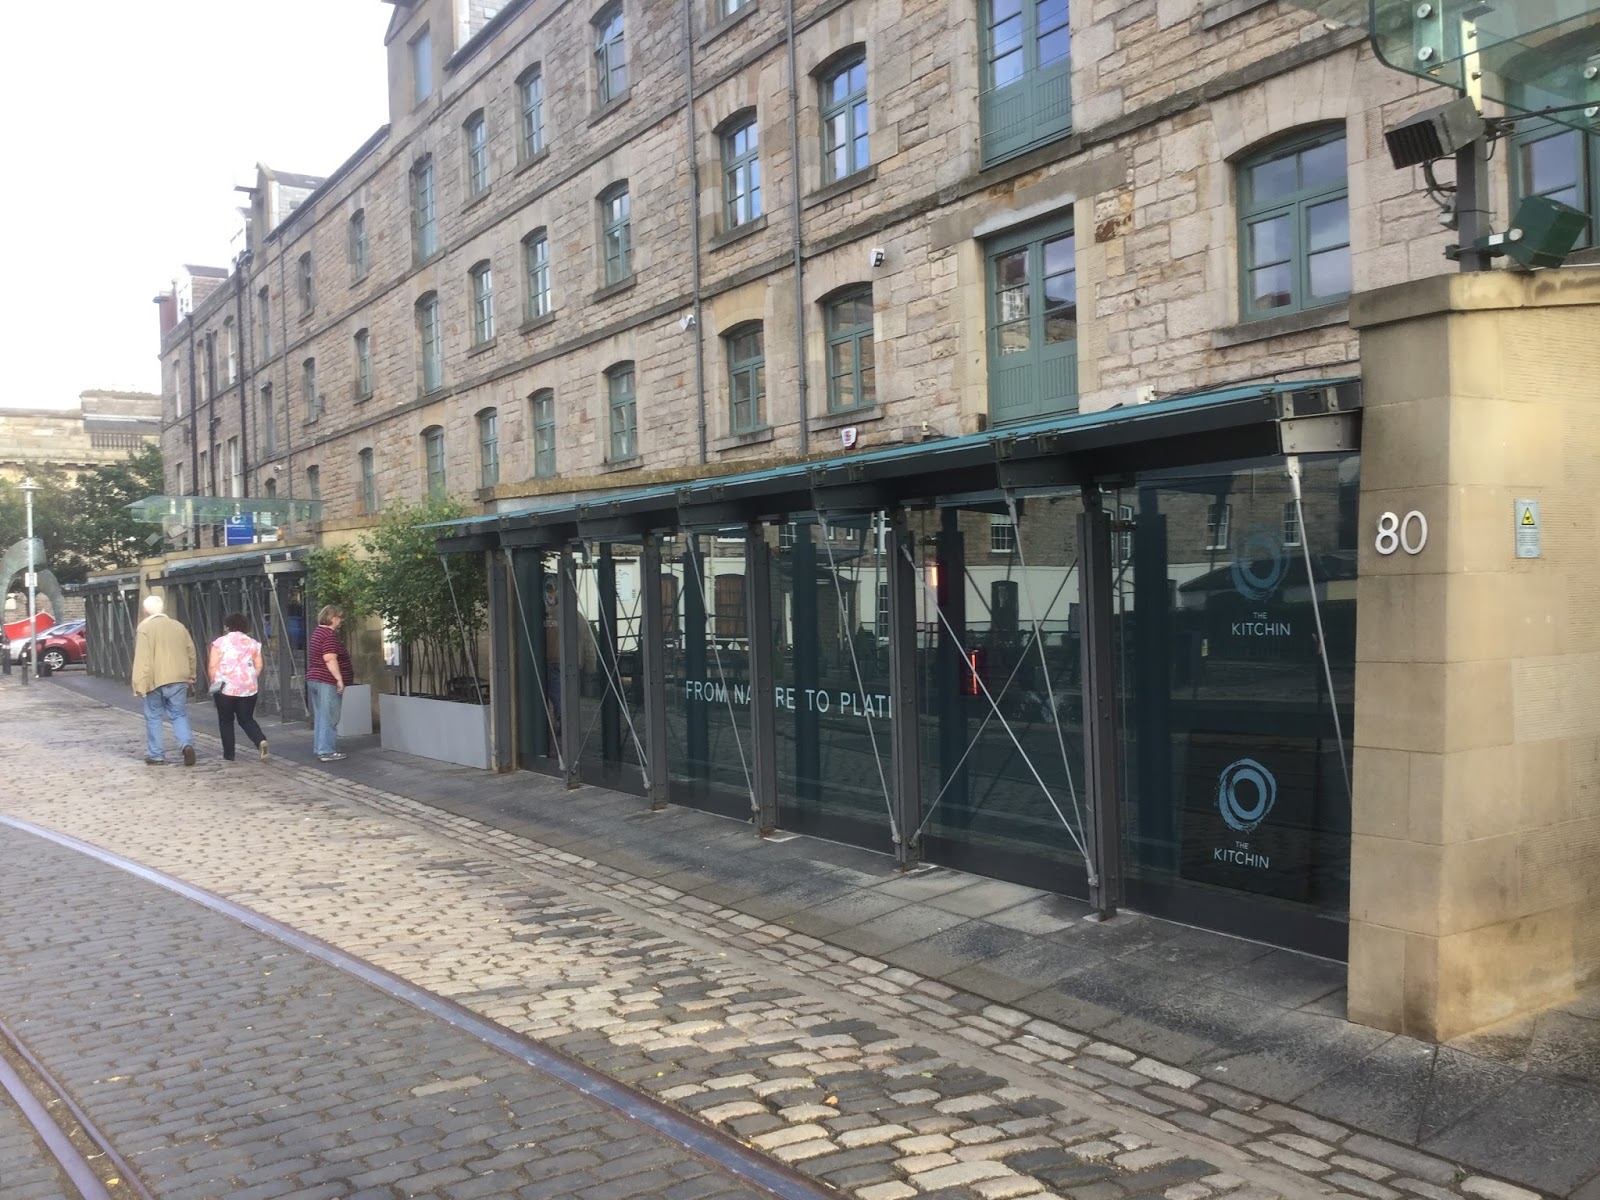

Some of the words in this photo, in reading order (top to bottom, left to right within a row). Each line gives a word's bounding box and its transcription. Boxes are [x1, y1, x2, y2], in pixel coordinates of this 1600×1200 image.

[1375, 510, 1428, 555] 80
[1253, 611, 1268, 620] THE
[1231, 622, 1291, 636] KITCHIN
[686, 680, 728, 703] FROM
[734, 684, 796, 710] NARE
[805, 689, 830, 713] TO
[1235, 840, 1250, 850] THE
[1213, 847, 1270, 869] KITCHIN
